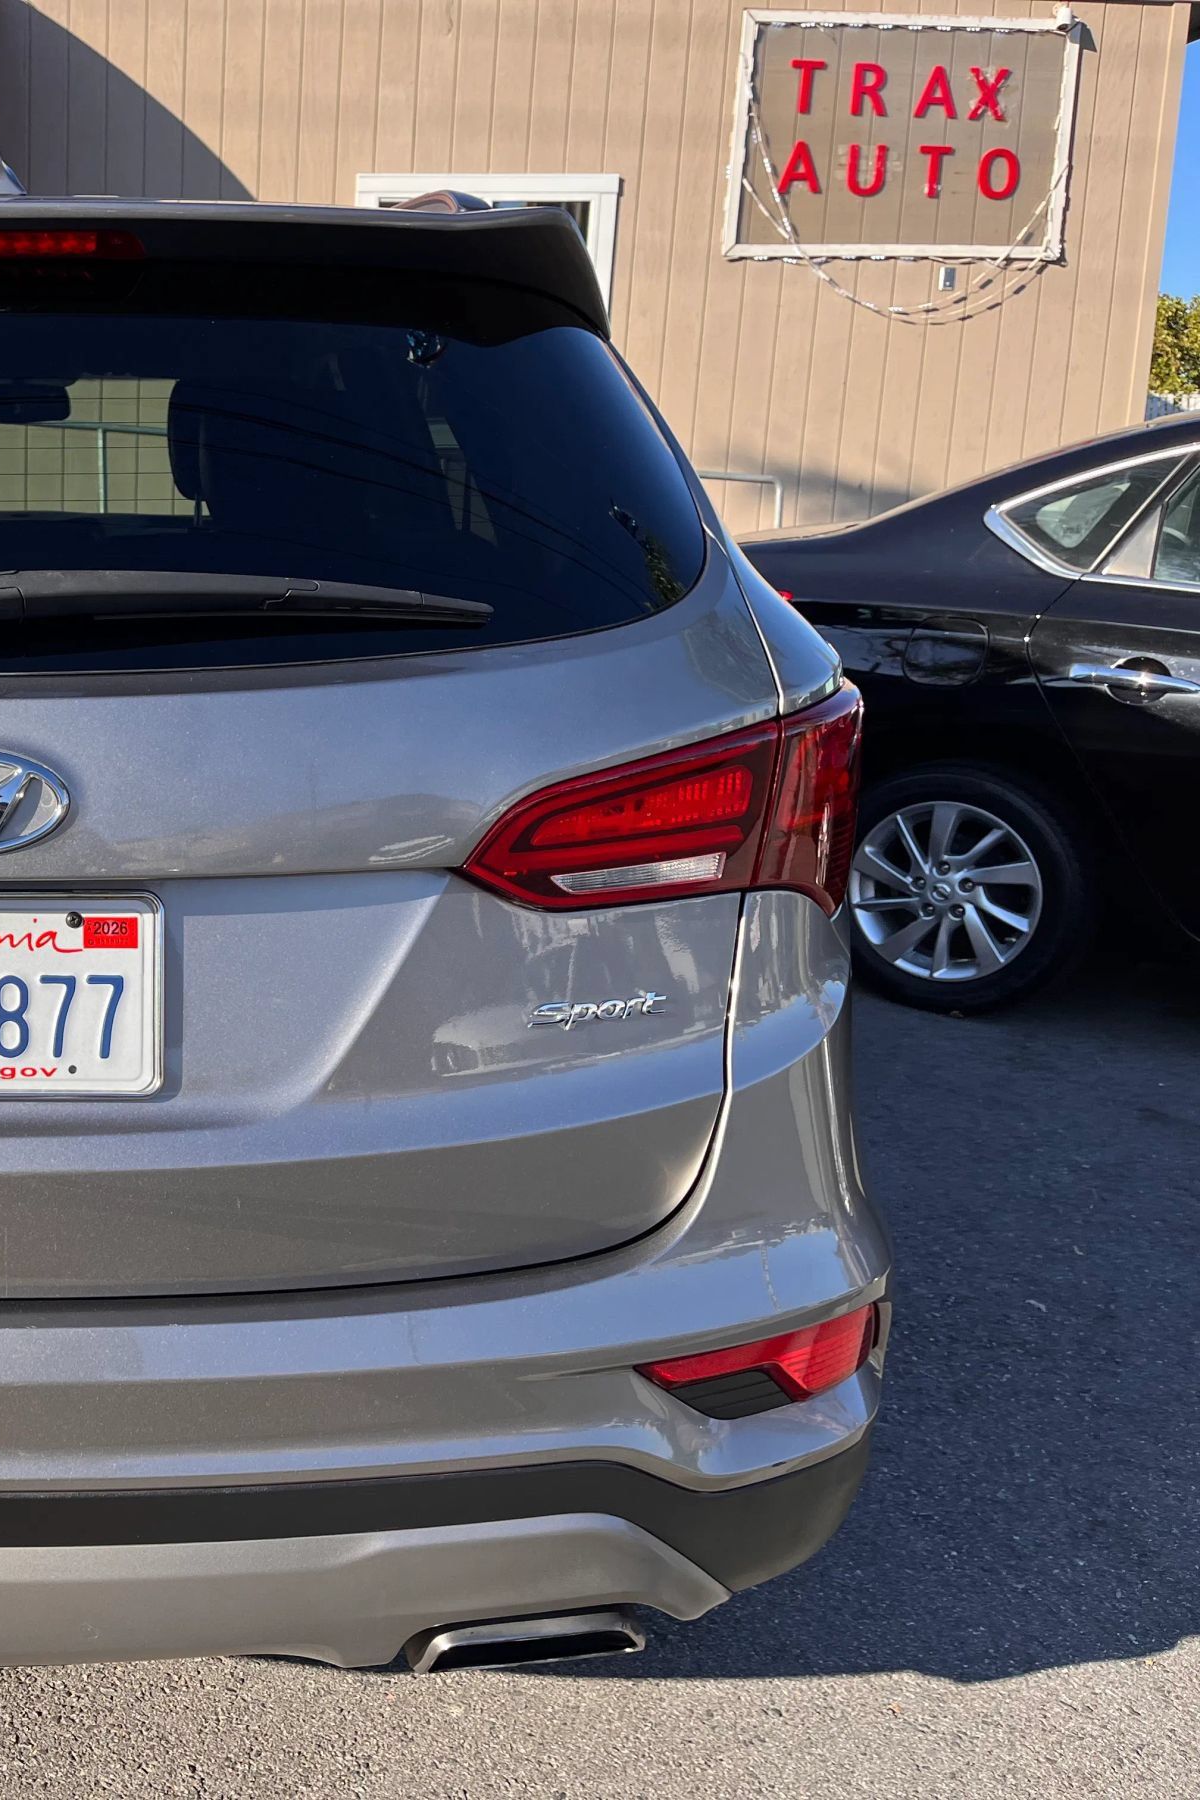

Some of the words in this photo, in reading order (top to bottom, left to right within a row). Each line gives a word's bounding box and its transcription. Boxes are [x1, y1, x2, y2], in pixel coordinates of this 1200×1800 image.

[791, 59, 1011, 122] TRAX
[777, 141, 1020, 201] AUTO
[93, 921, 129, 935] 2026
[527, 992, 667, 1031] Sport
